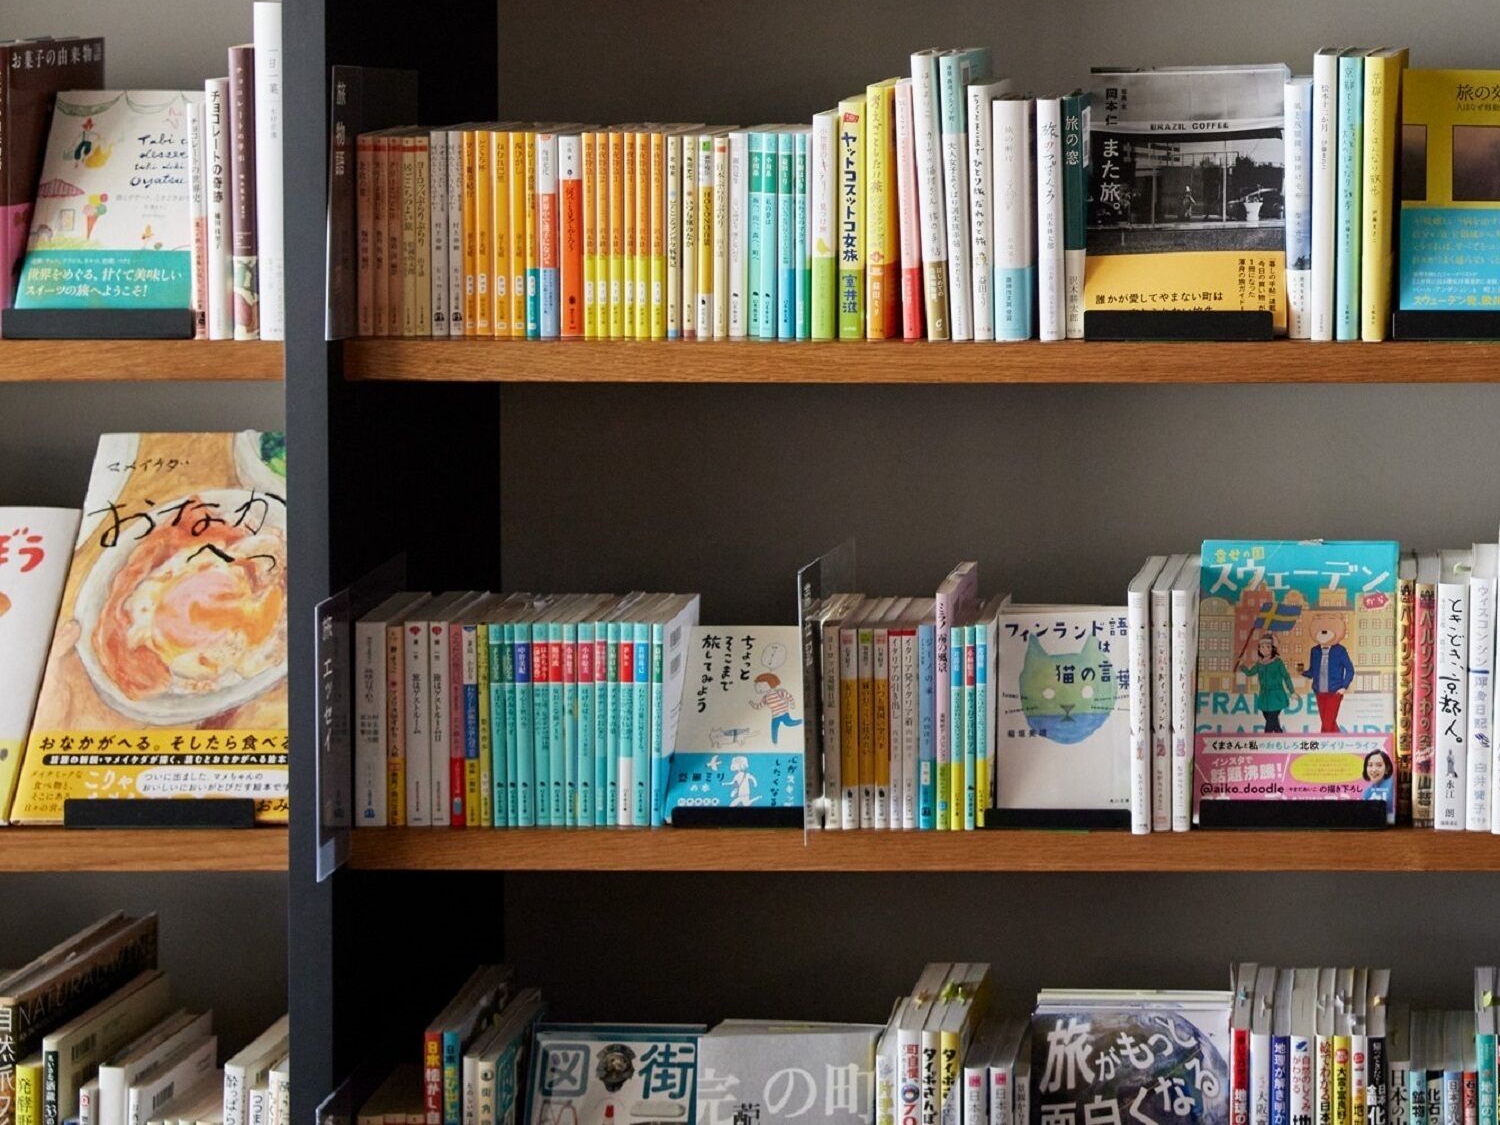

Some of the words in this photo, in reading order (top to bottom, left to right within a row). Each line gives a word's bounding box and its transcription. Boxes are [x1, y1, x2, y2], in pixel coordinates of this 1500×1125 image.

[1065, 115, 1080, 166] 旅の窓
[840, 130, 860, 263] ヤットコスットコ女旅
[1099, 138, 1122, 212] また旅。
[1095, 291, 1223, 305] 誰かが愛してやまない町は
[1209, 558, 1390, 594] スウェーデン
[695, 634, 721, 714] 旅してみよう
[639, 1042, 696, 1100] 街
